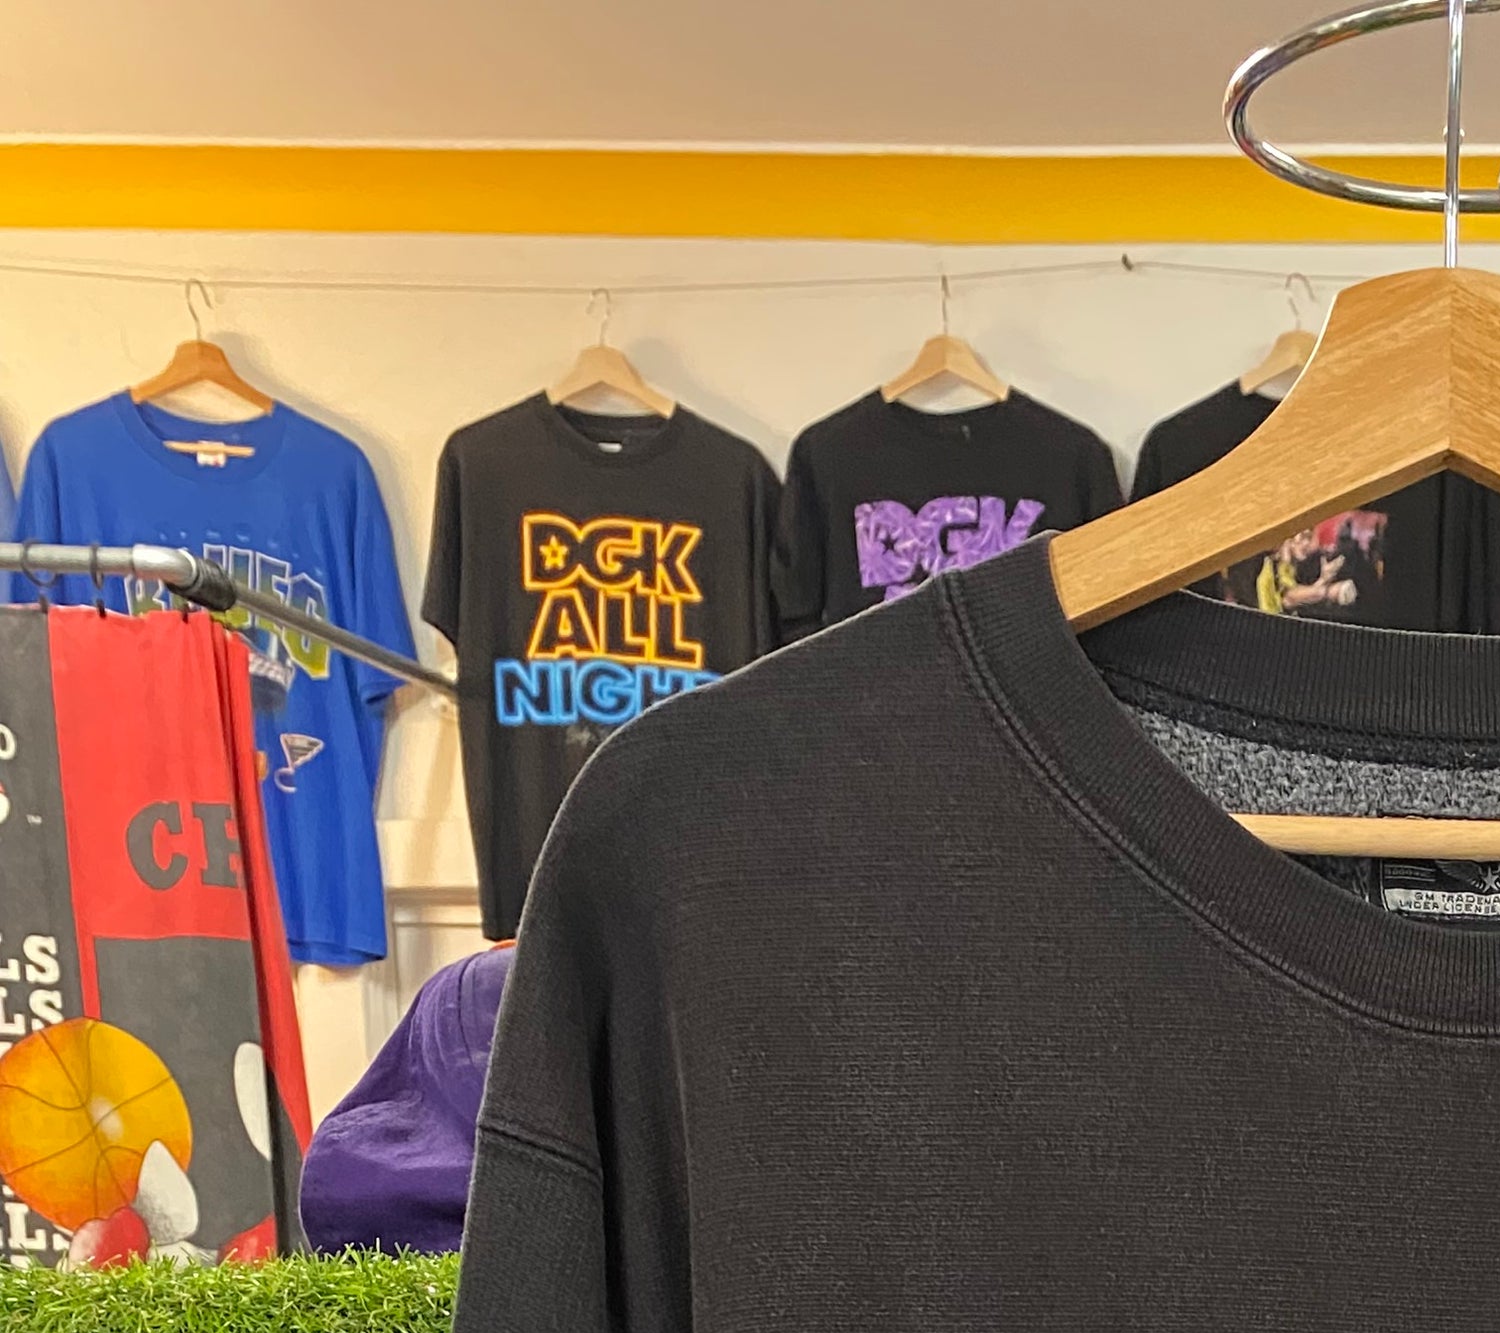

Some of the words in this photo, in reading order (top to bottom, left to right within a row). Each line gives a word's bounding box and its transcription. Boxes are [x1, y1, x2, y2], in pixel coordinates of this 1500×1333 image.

[522, 513, 702, 602] DGK
[854, 496, 1046, 588] DGK
[527, 588, 704, 669] ALL
